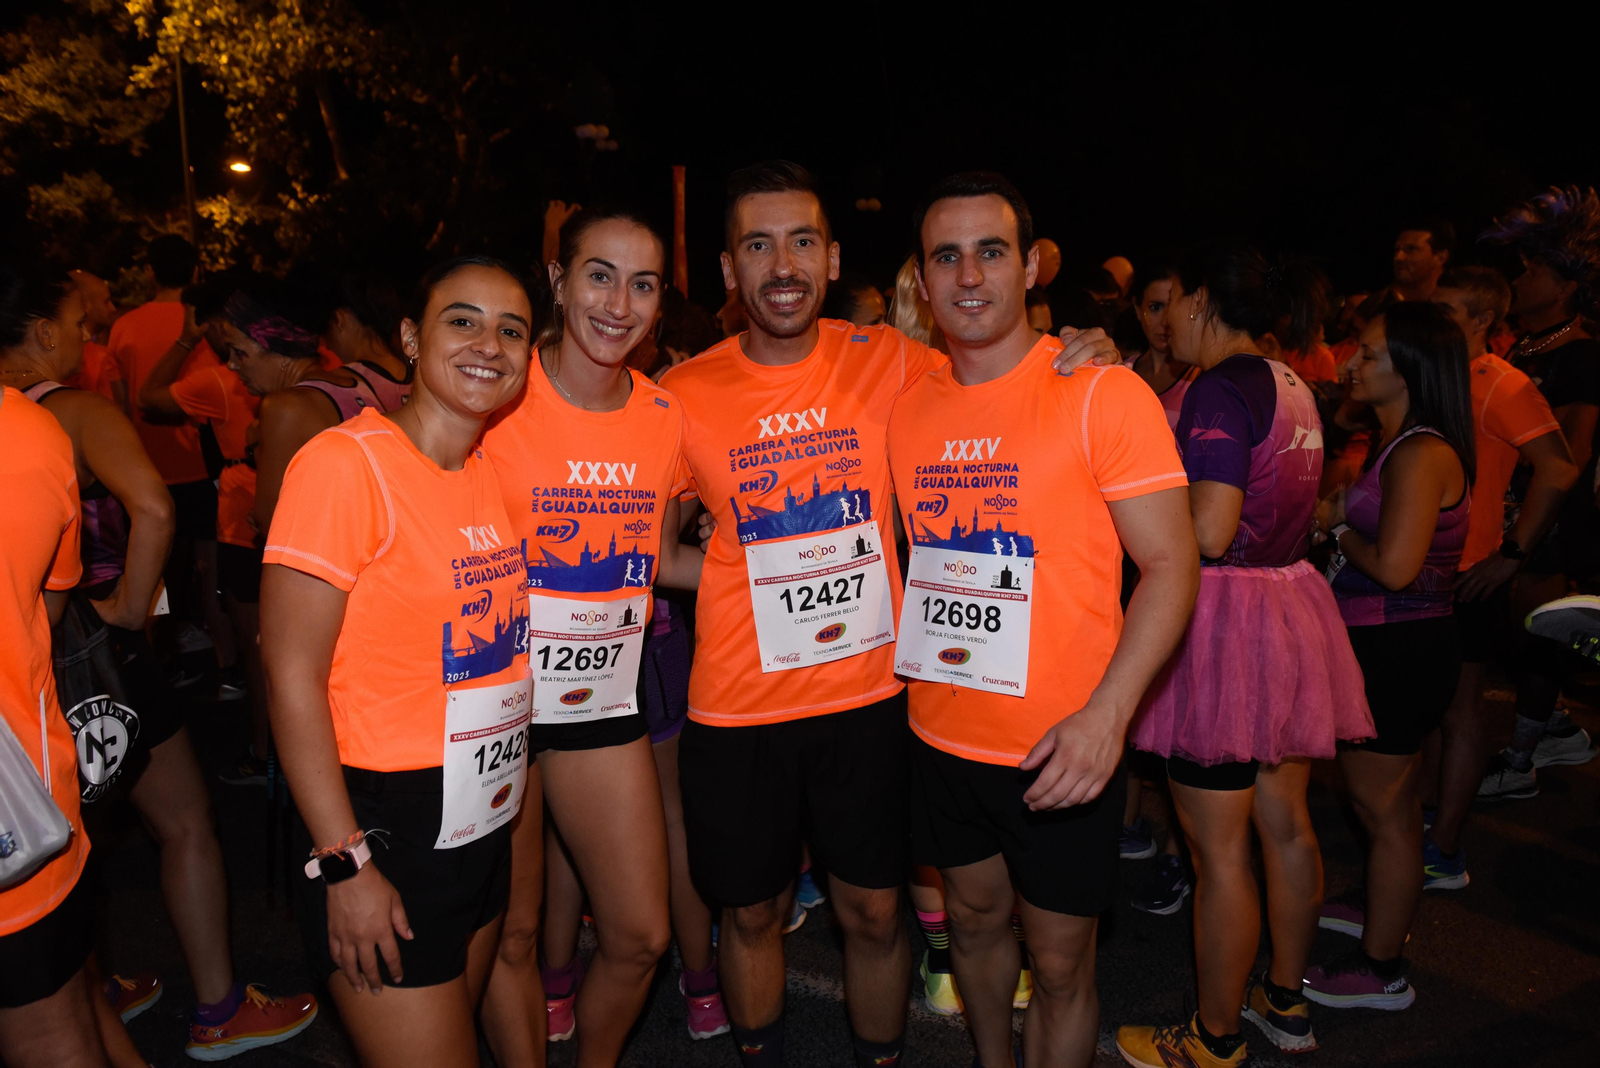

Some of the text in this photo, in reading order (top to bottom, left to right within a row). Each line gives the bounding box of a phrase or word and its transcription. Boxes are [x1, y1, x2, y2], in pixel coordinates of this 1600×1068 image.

[758, 407, 827, 439] XXXV
[729, 427, 857, 457] CARRERA NOCTURNA
[940, 437, 1001, 461] XXXV
[738, 438, 860, 469] GUADALQUIVIR
[566, 460, 637, 486] XXXV
[915, 463, 1019, 475] CARRERA NOCTURNA
[921, 475, 1018, 489] GUADALQUIVIR
[532, 487, 656, 500] CARRERA NOCTURNA
[531, 497, 539, 513] DEL
[541, 500, 655, 514] GUADALQUIVIR
[452, 545, 521, 570] CARRERA NOCTURN
[464, 557, 525, 587] GUADALQUIV
[793, 571, 820, 580] NOCTURNA
[829, 561, 860, 573] GUADALQUIVIR
[454, 571, 462, 590] DEL
[780, 572, 865, 614] 12427
[934, 584, 956, 592] NOCTURNA
[964, 589, 1000, 598] GUADALQUIVIR
[794, 605, 860, 625] CARLOS FERRER BELLO
[922, 596, 1001, 633] 12698
[595, 631, 623, 640] GUADALQUIVIR
[860, 631, 890, 645] Cruzcampo
[925, 629, 987, 644] BORJA FLORES VERDÚ
[537, 642, 624, 671] 12697
[446, 669, 470, 682] 2023
[567, 675, 597, 683] MARTÍNEZ
[598, 673, 614, 681] LÓPEZ
[982, 676, 1019, 689] Cruzcampo
[601, 702, 631, 712] Cruzcampo
[469, 728, 491, 738] CARRERA
[481, 777, 496, 788] ELENA
[1384, 977, 1406, 994] HOKA
[199, 1028, 228, 1038] HOKA
